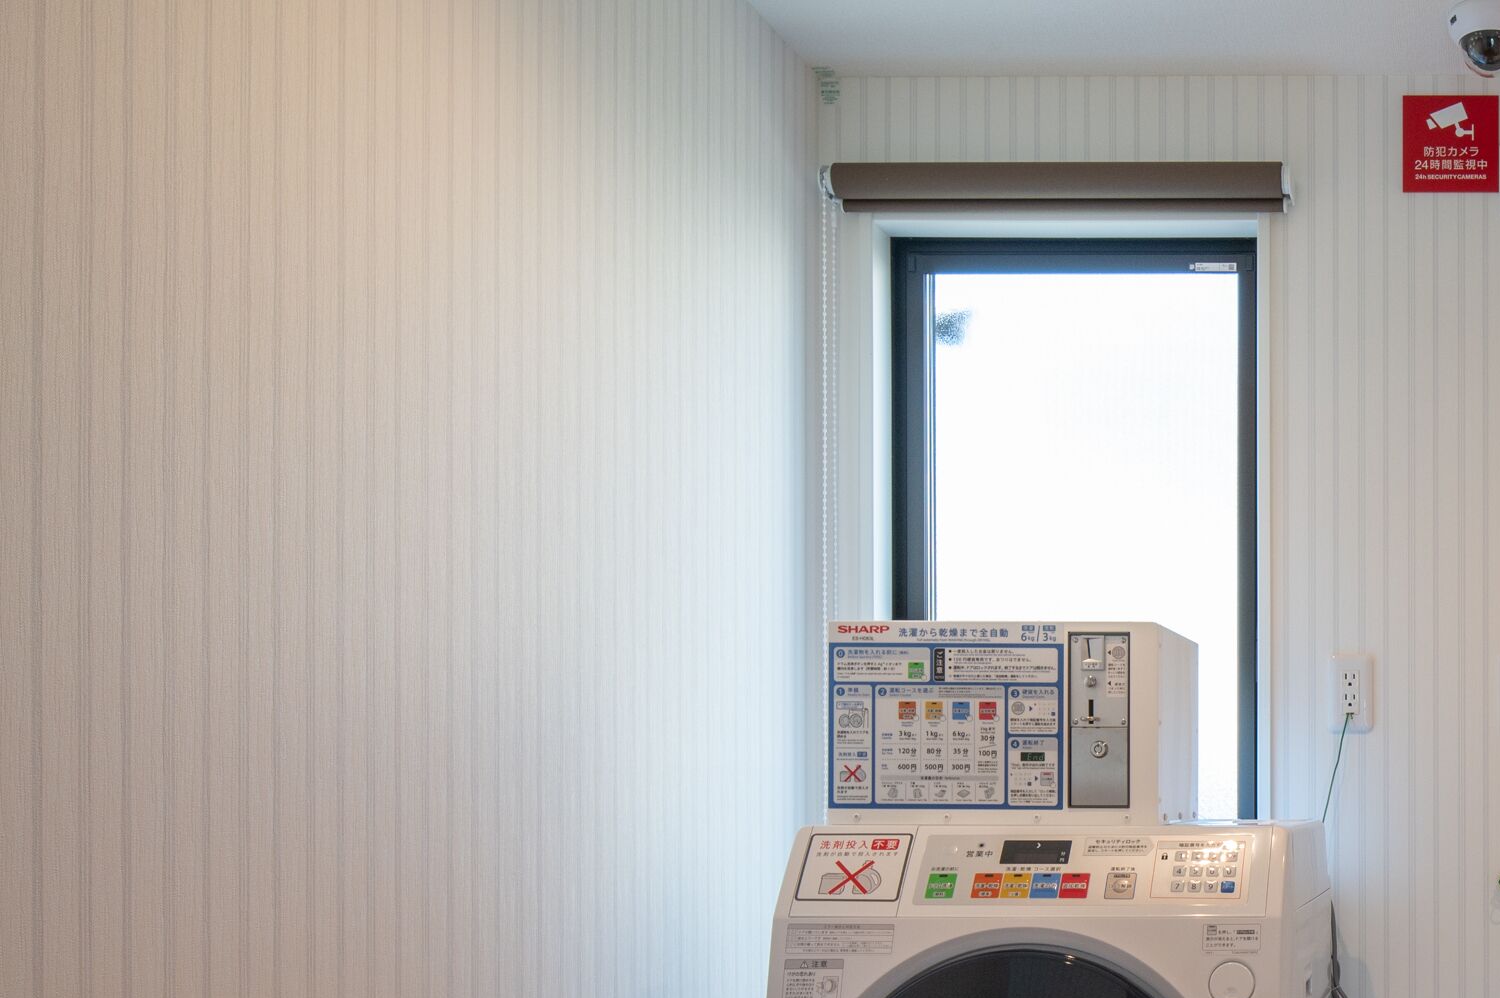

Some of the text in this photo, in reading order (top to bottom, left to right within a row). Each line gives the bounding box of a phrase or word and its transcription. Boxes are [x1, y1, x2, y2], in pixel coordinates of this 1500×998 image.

[1423, 146, 1480, 158] 防犯カメラ
[1414, 158, 1488, 170] 24時間監視中
[837, 625, 890, 634] SHARP
[898, 627, 1009, 638] 洗濯から乾燥まで全自動
[926, 747, 942, 755] 80分
[952, 747, 969, 755] 35分
[897, 763, 917, 771] 600円
[924, 763, 944, 771] 500円
[951, 763, 971, 771] 300円
[819, 839, 899, 850] 洗剤投入 不要
[965, 850, 994, 858] 営業中
